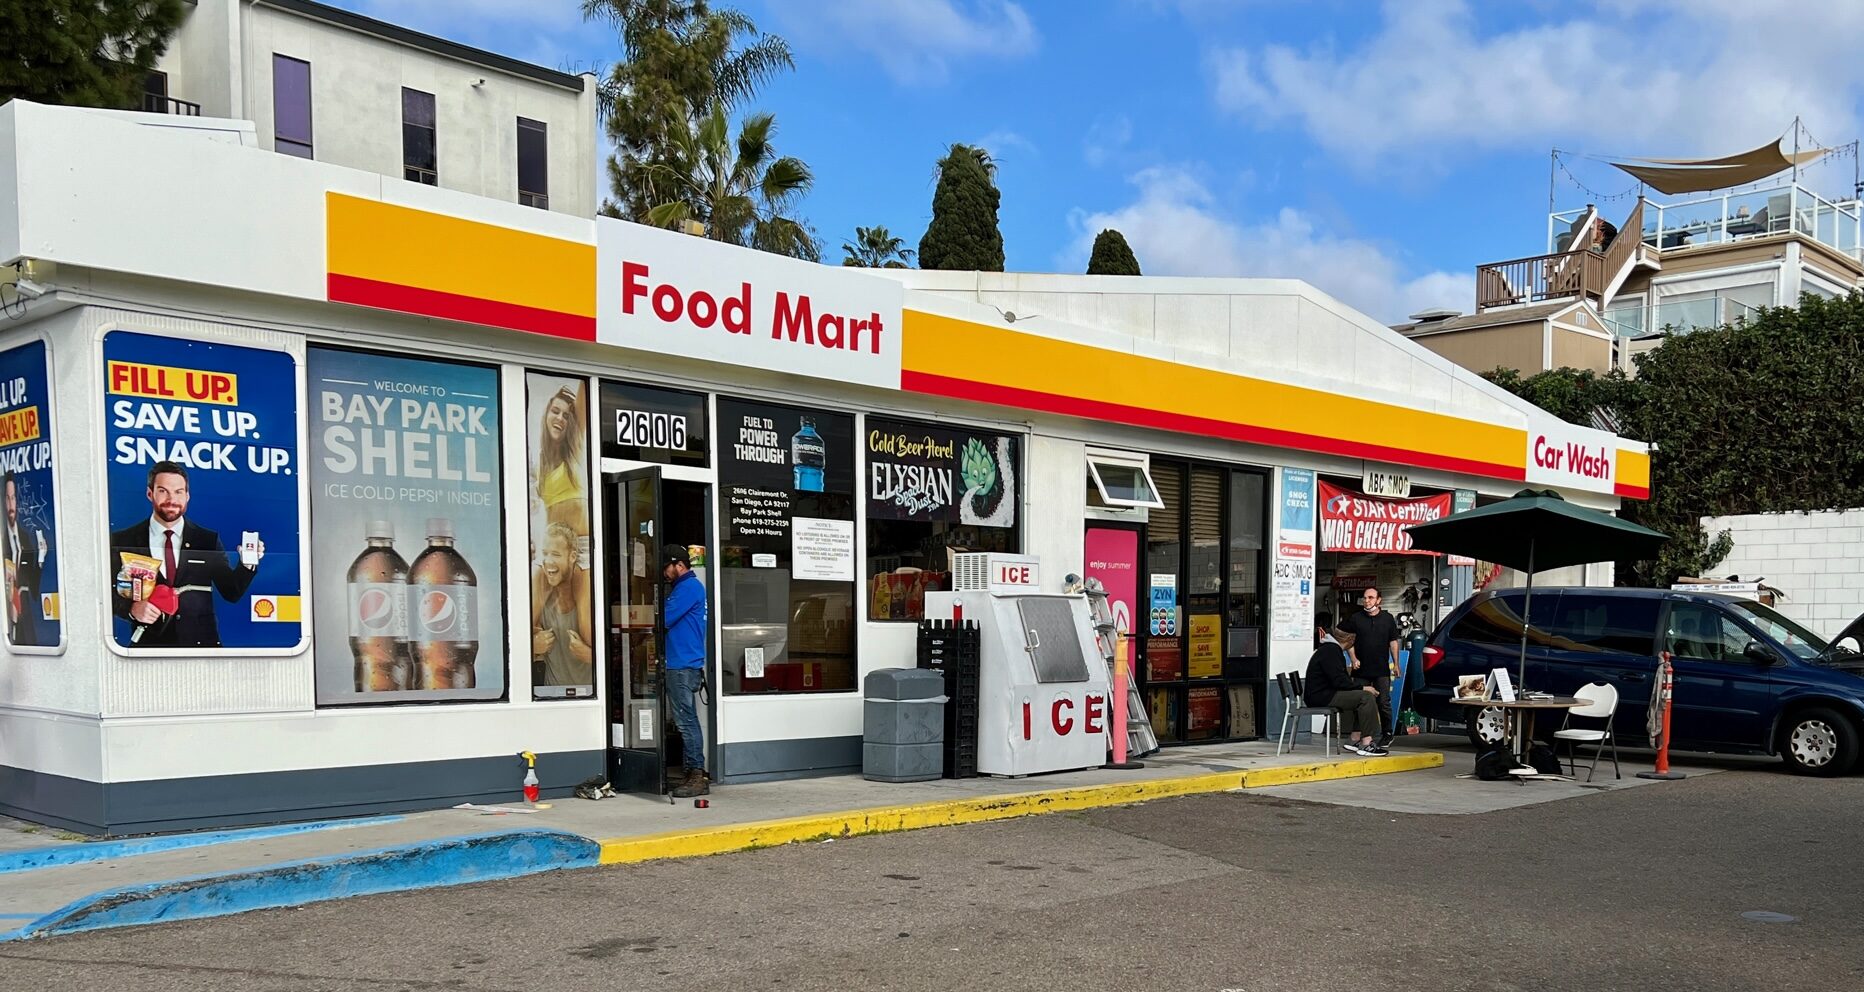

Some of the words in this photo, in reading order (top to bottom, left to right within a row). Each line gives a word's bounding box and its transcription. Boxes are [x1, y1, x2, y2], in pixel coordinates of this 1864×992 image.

[622, 261, 752, 335] Food
[772, 291, 883, 354] Mart
[10, 377, 27, 406] UP.
[112, 364, 174, 396] FILL
[186, 372, 234, 402] UP.
[374, 380, 428, 396] WELCOME
[430, 386, 446, 397] TO
[113, 400, 201, 434] SAVE
[212, 410, 260, 439] UP.
[322, 391, 394, 426] BAY
[400, 398, 488, 435] PARK
[744, 416, 762, 428] FUEL
[763, 418, 772, 430] TO
[0, 414, 18, 443] AVE
[20, 409, 38, 438] UP.
[618, 412, 685, 448] 2606
[740, 428, 778, 447] POWER
[115, 436, 237, 471] SNACK
[248, 446, 292, 476] UP.
[323, 425, 490, 482] SHELL
[870, 430, 894, 454] Cold
[896, 434, 924, 458] Beer
[924, 436, 954, 460] Here!
[0, 445, 30, 477] NACK
[33, 442, 52, 470] UP.
[1534, 435, 1564, 470] Car
[1567, 442, 1610, 480] Wash
[325, 484, 348, 498] ICE
[352, 485, 395, 500] COLD
[448, 492, 492, 506] INSIDE
[748, 489, 779, 498] Clairemont
[872, 462, 952, 506] ELYSIAN
[1289, 490, 1308, 500] SMOG
[1368, 472, 1384, 493] ABC
[1388, 474, 1409, 495] SMOG
[740, 508, 752, 516] Bay
[752, 508, 766, 516] Park
[908, 493, 932, 516] Dust
[1286, 499, 1310, 508] CHECK
[1354, 498, 1386, 519] STAR
[1388, 502, 1440, 522] Certified
[732, 516, 751, 524] phone
[1355, 520, 1396, 550] CHECK
[1002, 566, 1030, 584] ICE
[1090, 560, 1107, 570] enjoy
[1108, 562, 1131, 570] summer
[1274, 563, 1290, 578] ABC
[1292, 564, 1312, 580] SMOG
[1154, 588, 1172, 600] ZYN
[1197, 644, 1210, 652] SAVE
[1023, 690, 1104, 740] ICE
